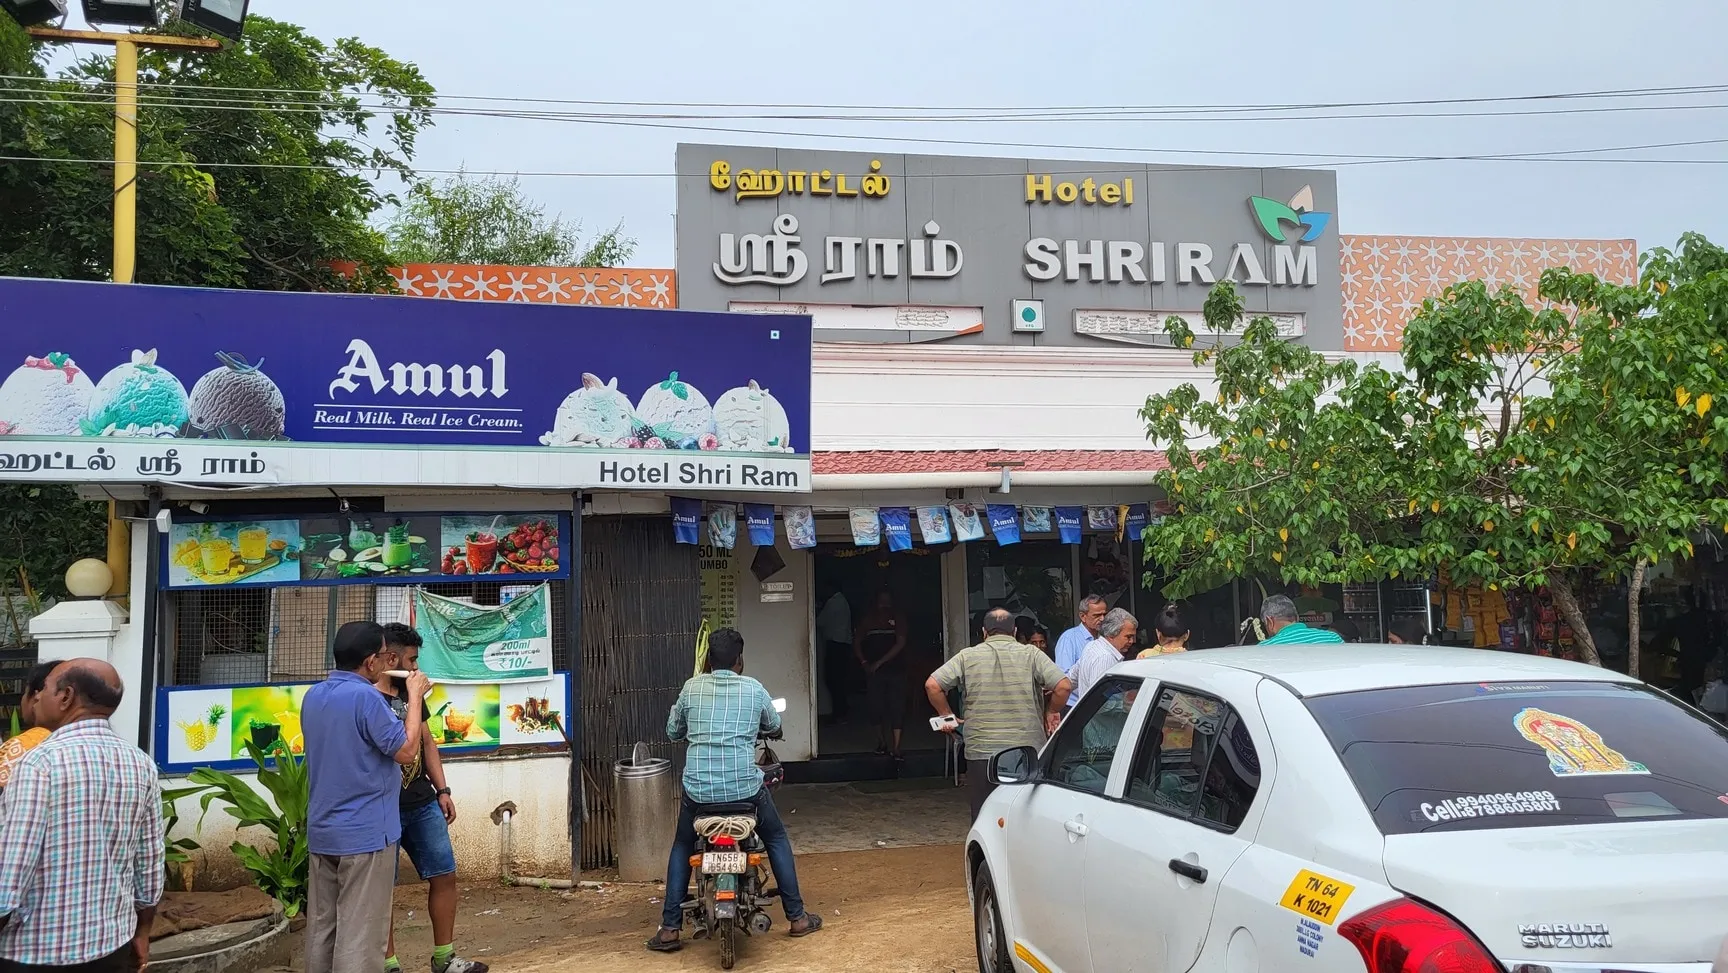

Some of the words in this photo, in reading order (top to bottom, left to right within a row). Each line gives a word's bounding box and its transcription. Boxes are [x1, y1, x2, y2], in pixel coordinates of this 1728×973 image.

[709, 159, 891, 205] ஹோட்டல்
[1025, 174, 1134, 207] Hotel
[820, 219, 964, 286] ராம்
[329, 338, 509, 400] Amul
[314, 410, 351, 424] Real
[354, 411, 396, 425] Milk.
[400, 412, 437, 426] Real
[440, 413, 463, 426] Ice
[467, 414, 523, 428] Cream.
[200, 451, 266, 476] ராம்
[600, 461, 669, 483] Hotel
[679, 462, 731, 485] Shri
[741, 464, 798, 487] Ram
[673, 513, 696, 524] Amul
[747, 516, 770, 525] Amul
[993, 516, 1015, 527] Amul
[1059, 516, 1080, 524] Amul
[1126, 513, 1145, 521] Amul
[885, 523, 906, 531] Amul
[701, 560, 728, 570] UMBO
[500, 640, 531, 651] 200ml
[1456, 790, 1555, 807] 9940964989
[1305, 876, 1324, 892] TN
[1321, 883, 1340, 898] 64
[1293, 893, 1306, 908] K
[1306, 898, 1332, 918] 1021
[1517, 923, 1610, 935] MARUTI
[1521, 934, 1613, 948] SUZUKI
